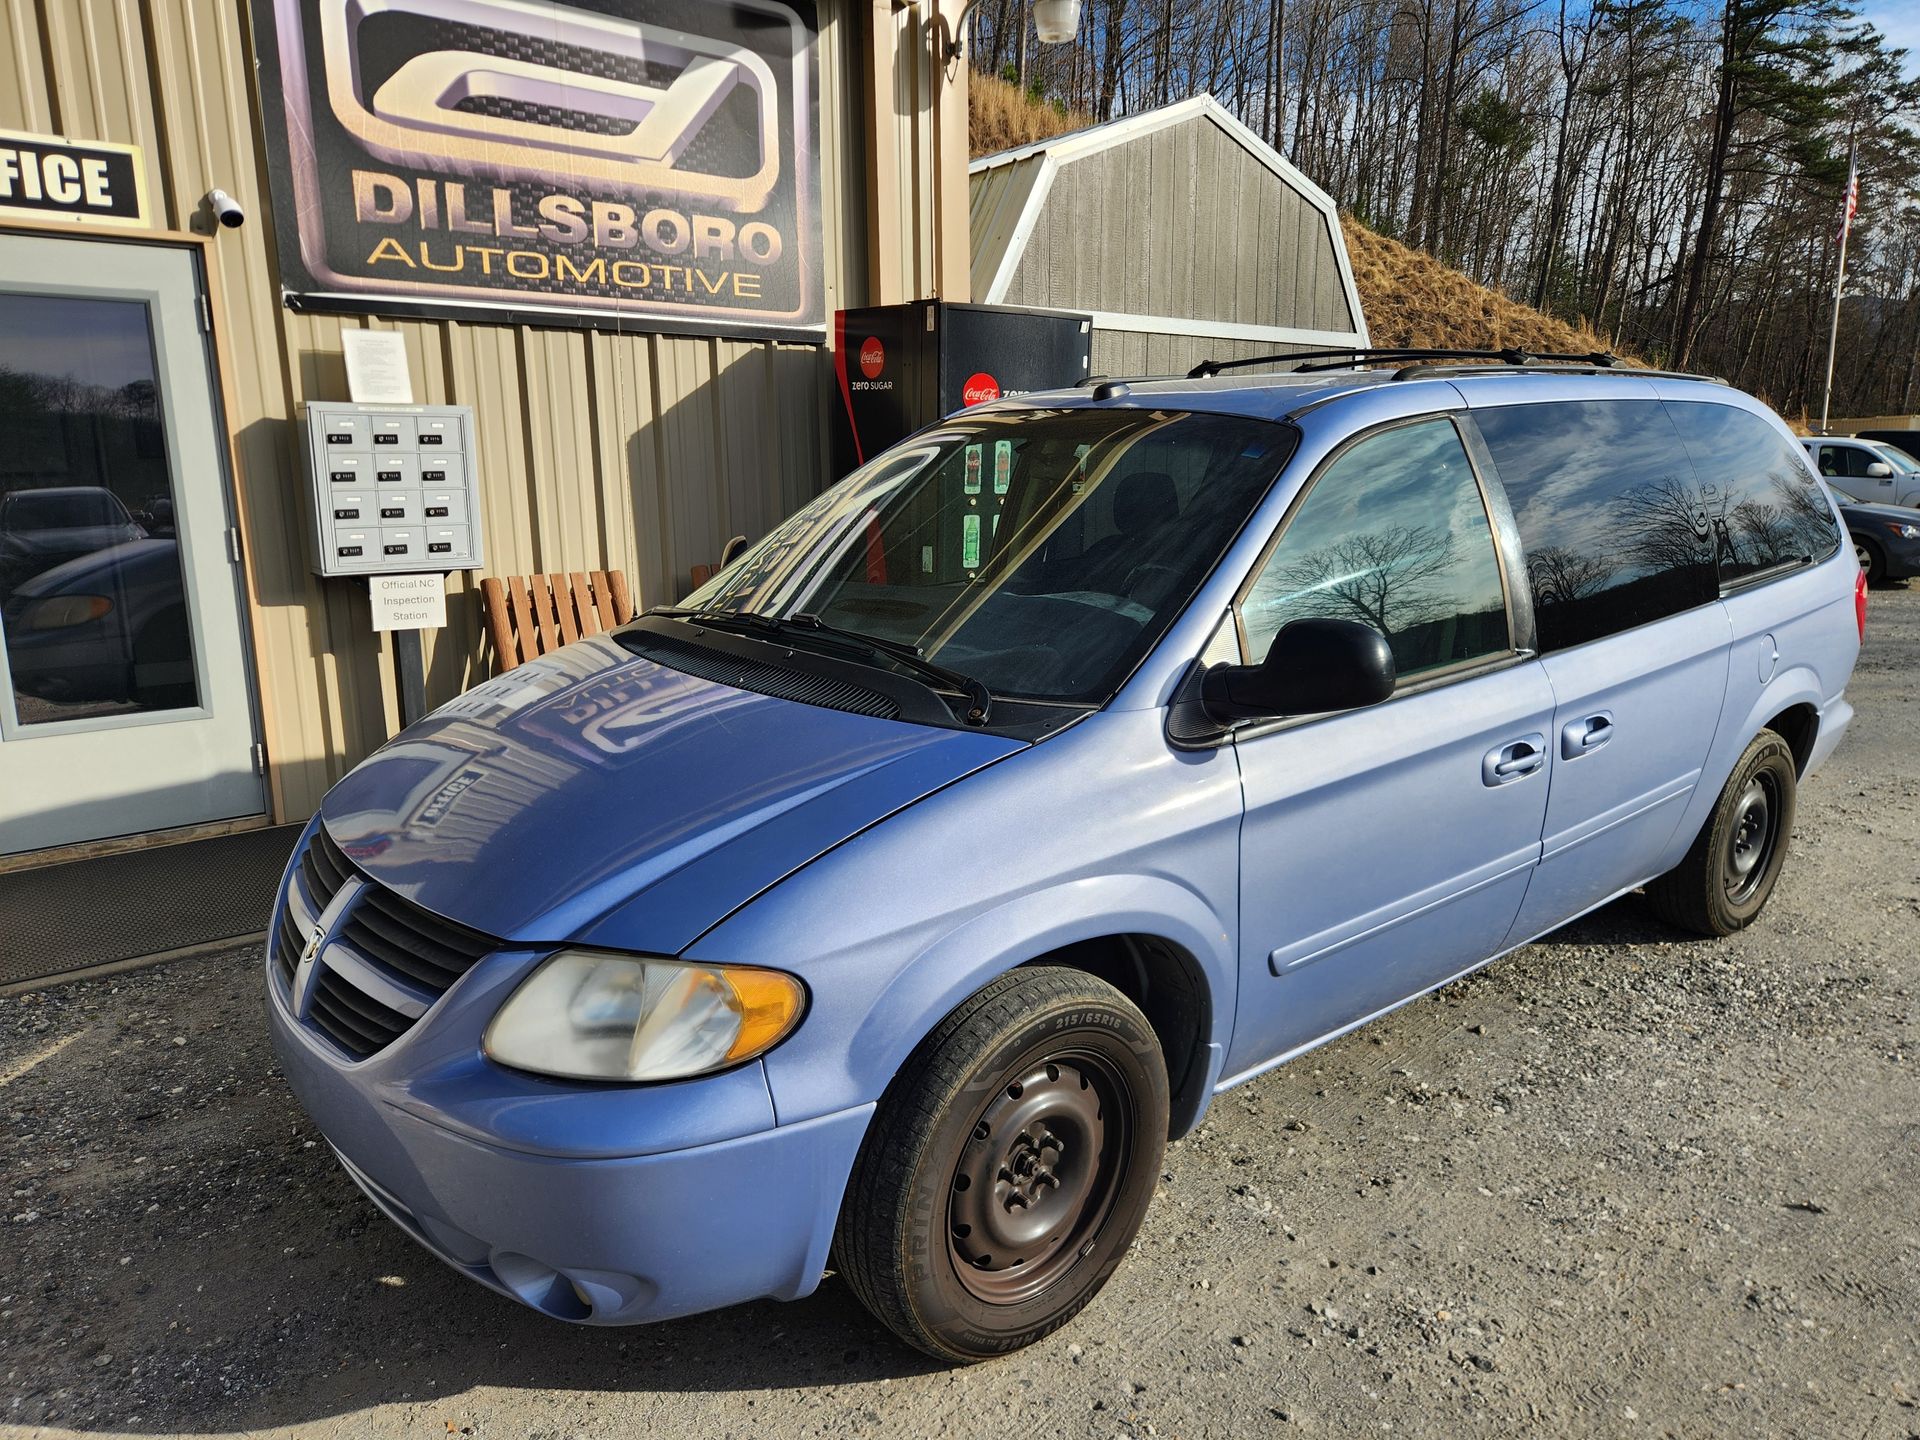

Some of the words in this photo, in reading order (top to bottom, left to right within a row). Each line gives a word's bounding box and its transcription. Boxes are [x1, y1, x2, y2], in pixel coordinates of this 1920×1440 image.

[351, 169, 782, 265] DILLSBORO
[367, 237, 762, 298] AUTOMOTIVE
[852, 381, 870, 390] zero
[870, 381, 893, 390] SUGAR
[965, 388, 998, 401] Coca-Cola
[382, 580, 417, 590] Official
[419, 579, 435, 588] NC
[383, 595, 435, 606] Inspection
[393, 612, 428, 621] Station
[1055, 1012, 1122, 1030] 215/65R16
